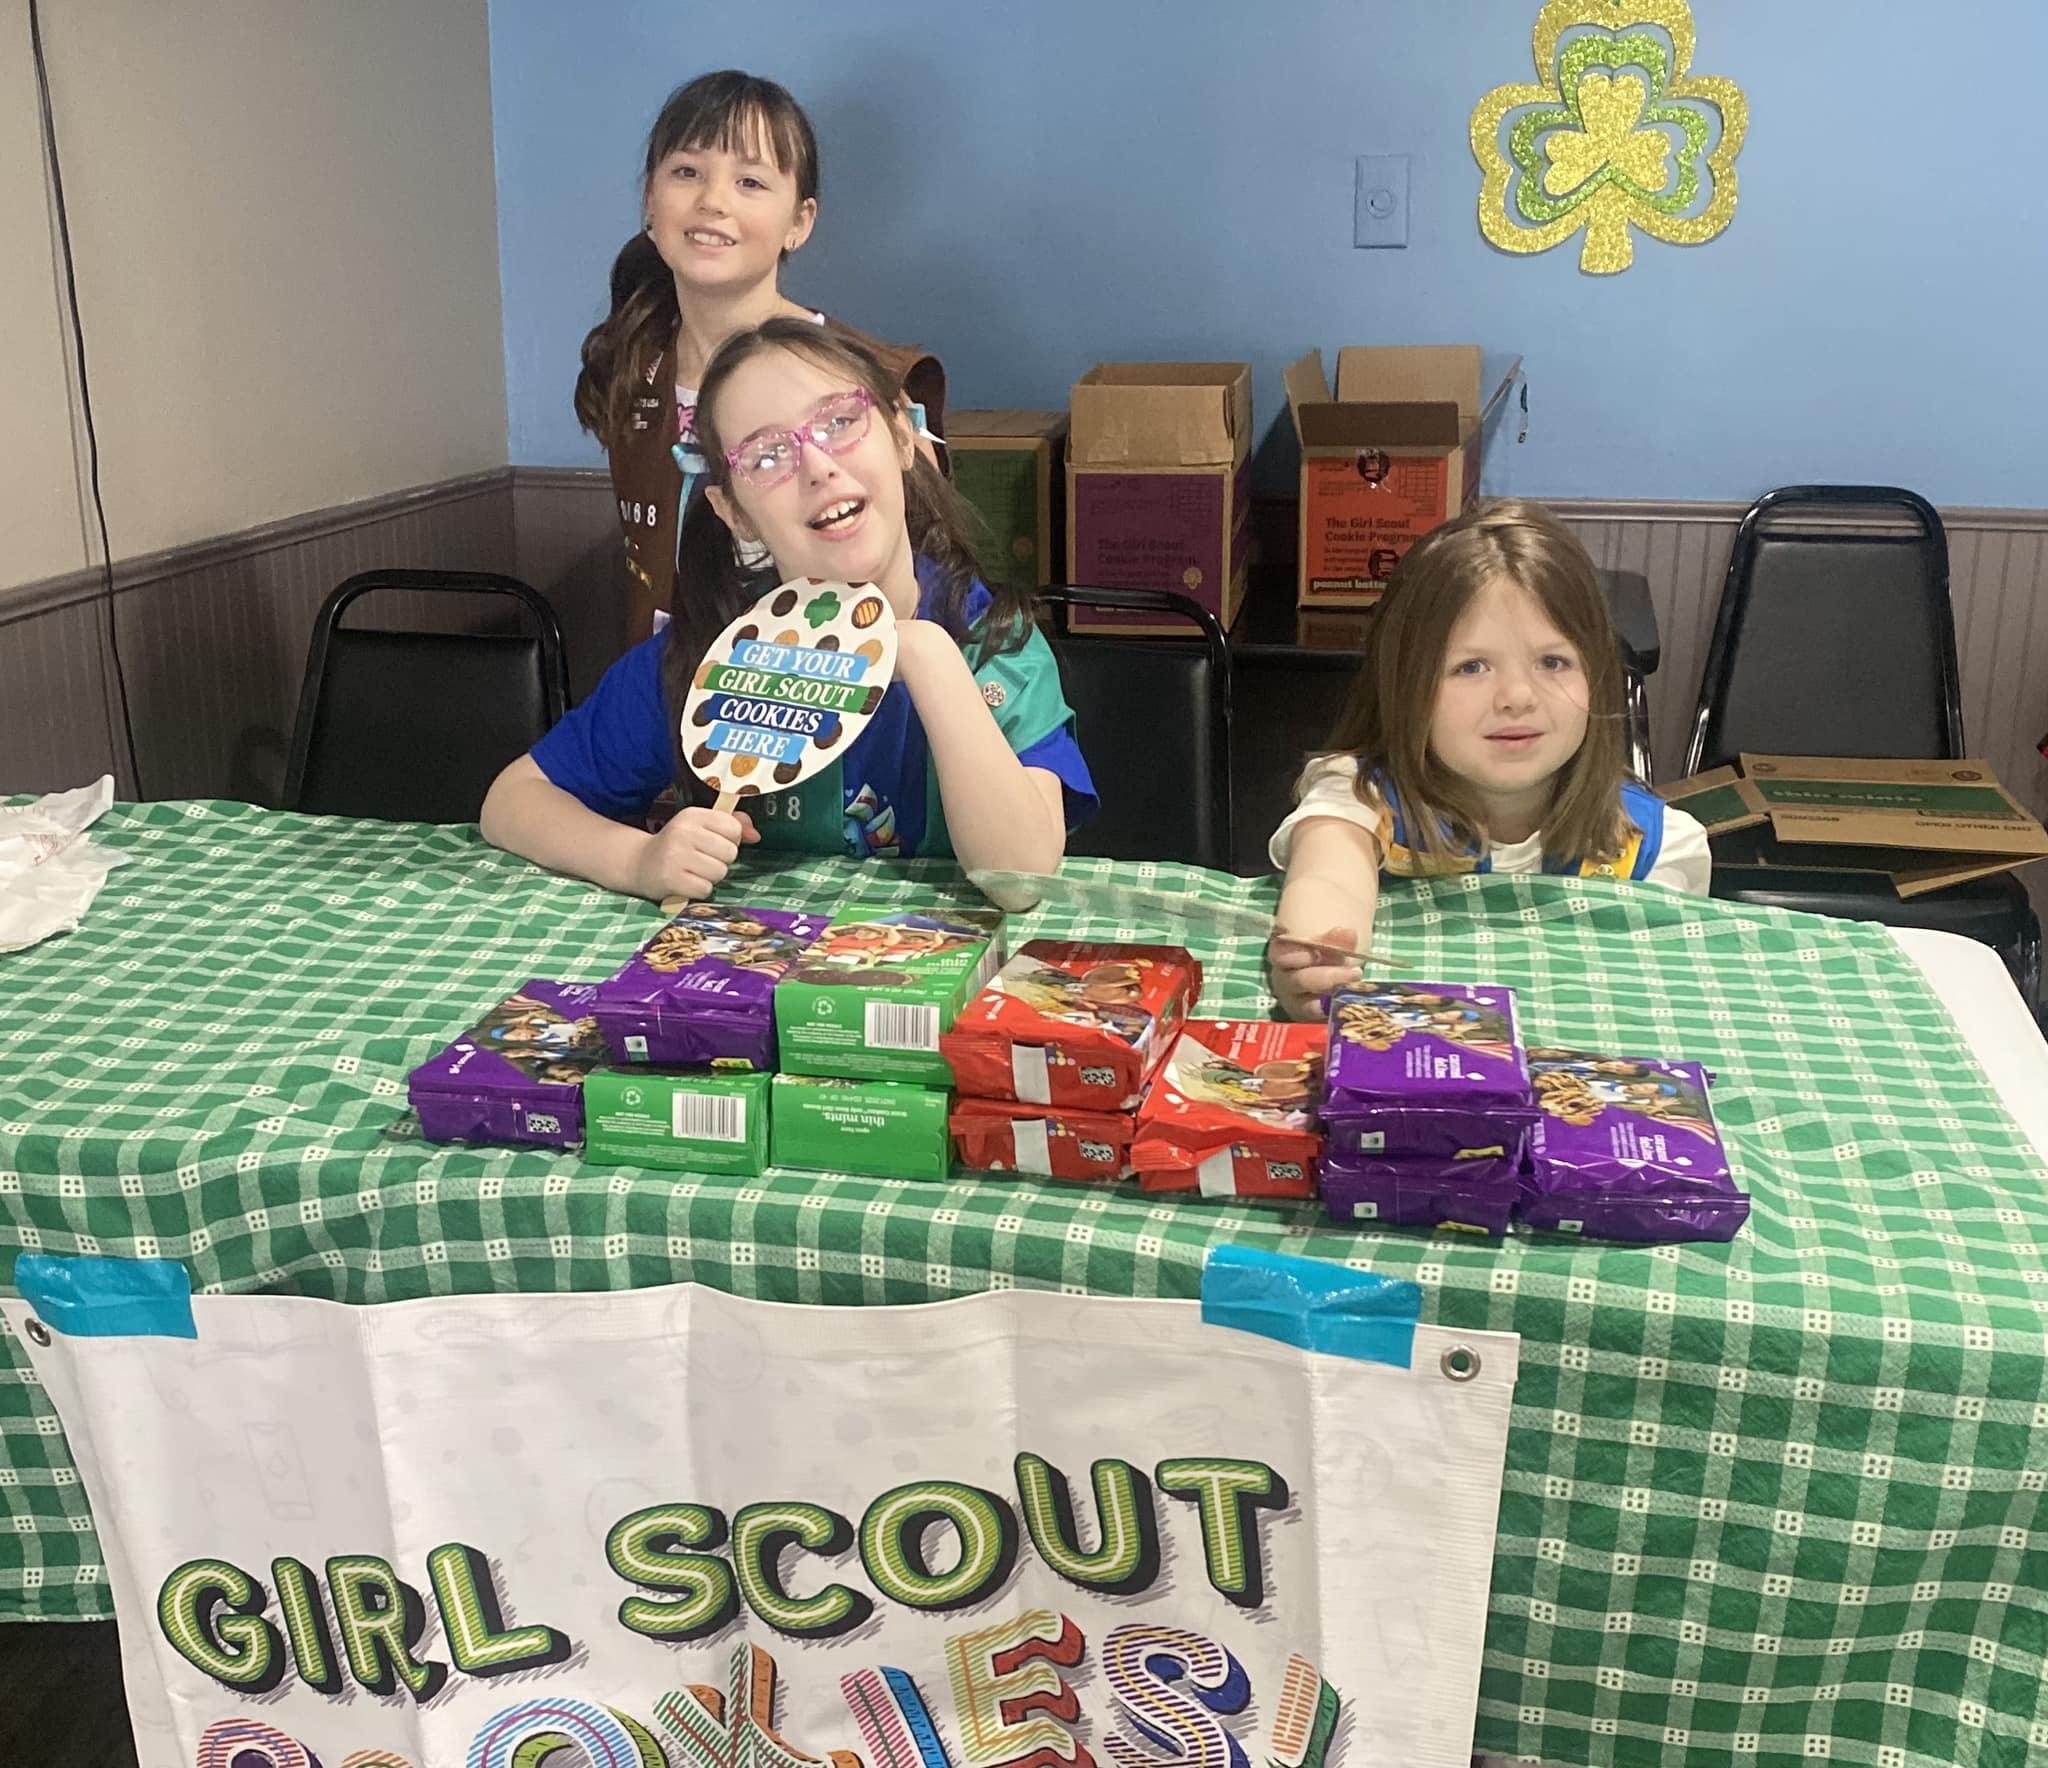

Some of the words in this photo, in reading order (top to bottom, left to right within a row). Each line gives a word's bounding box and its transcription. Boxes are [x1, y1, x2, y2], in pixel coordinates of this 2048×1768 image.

[1325, 531, 1365, 542] Cookie
[1326, 517, 1347, 529] The
[1350, 517, 1373, 529] Girl
[1376, 517, 1410, 529] Scout
[742, 643, 791, 668] GET
[793, 648, 855, 678] YOUR
[718, 669, 774, 694] GIRL
[774, 677, 855, 708] SCOUT
[719, 698, 823, 734] COOKIES
[722, 728, 791, 757] HERE
[860, 1114, 885, 1128] thin
[157, 1541, 572, 1701] GIRL
[605, 1451, 1290, 1641] SCOUT
[197, 1607, 1340, 1768] KIES!
